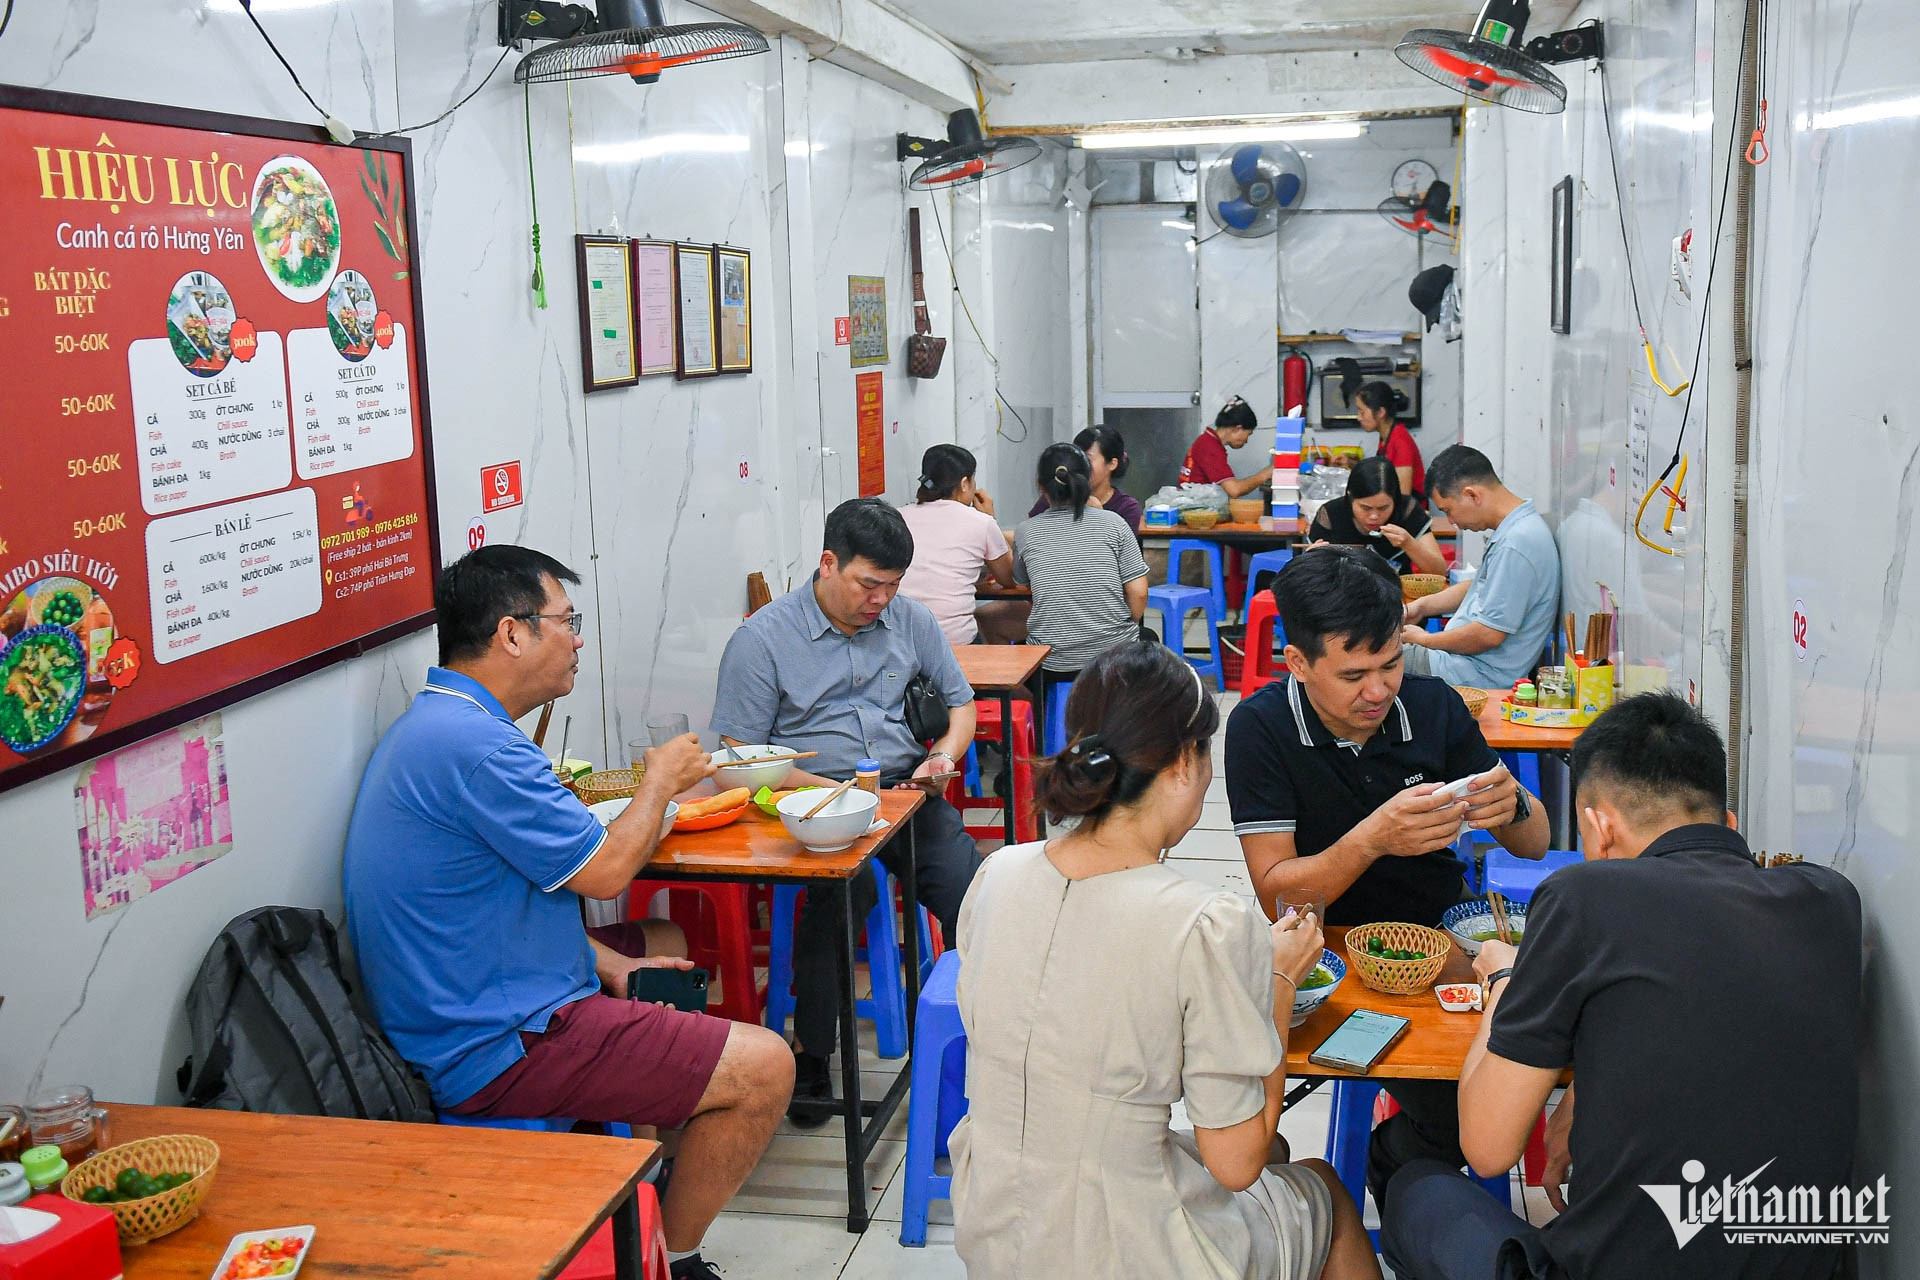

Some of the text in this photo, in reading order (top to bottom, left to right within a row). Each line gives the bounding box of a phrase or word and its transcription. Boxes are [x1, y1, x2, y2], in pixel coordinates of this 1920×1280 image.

[33, 132, 247, 217] HIỆU LỰC
[56, 222, 244, 254] Canh cá rô Hưng Yên
[34, 267, 111, 293] BÁT ĐẶC
[55, 293, 95, 317] BIỆT
[376, 324, 393, 337] 400k
[55, 334, 109, 353] 50-60K
[234, 334, 255, 349] 300k
[338, 364, 376, 380] SET CÁ TO
[186, 378, 236, 398] SET CÁ BÉ
[364, 385, 383, 393] CHƯNG
[305, 392, 313, 402] CÁ
[62, 394, 115, 416] 50-60K
[216, 406, 226, 415] ỚT
[228, 403, 254, 414] CHƯNG
[147, 410, 206, 425] CÁ 300g
[307, 419, 319, 430] CHẢ
[218, 420, 248, 431] Chili sauce
[149, 432, 162, 440] Fish
[219, 433, 241, 445] NƯỚC
[242, 430, 262, 441] DÙNG
[273, 428, 284, 437] chai
[150, 446, 167, 456] CHẢ
[309, 447, 325, 457] BÁNH
[327, 445, 335, 453] ĐA
[68, 453, 121, 477] 50-60K
[152, 461, 182, 472] Fish cake
[740, 462, 748, 478] 08
[153, 474, 175, 488] BÁNH
[177, 473, 188, 483] ĐA
[154, 493, 168, 503] Rice
[74, 513, 126, 538] 50-60K
[215, 514, 251, 536] BÁN LẺ
[321, 535, 340, 549] 0972
[341, 531, 355, 543] 701
[375, 520, 392, 534] 0976
[469, 525, 484, 550] 09
[251, 538, 276, 550] CHƯNG
[163, 561, 174, 573] CÁ
[241, 554, 270, 568] Chili sauce
[43, 549, 84, 574] SIÊU
[85, 558, 119, 591] HỜI
[241, 571, 263, 582] NƯỚC
[264, 564, 283, 575] DÙNG
[164, 579, 177, 589] Fish
[165, 590, 182, 604] CHẢ
[167, 609, 180, 619] Fish
[168, 621, 189, 634] BÁNH
[191, 617, 202, 628] ĐA
[1794, 611, 1806, 649] 02
[1405, 773, 1424, 786] BOSS
